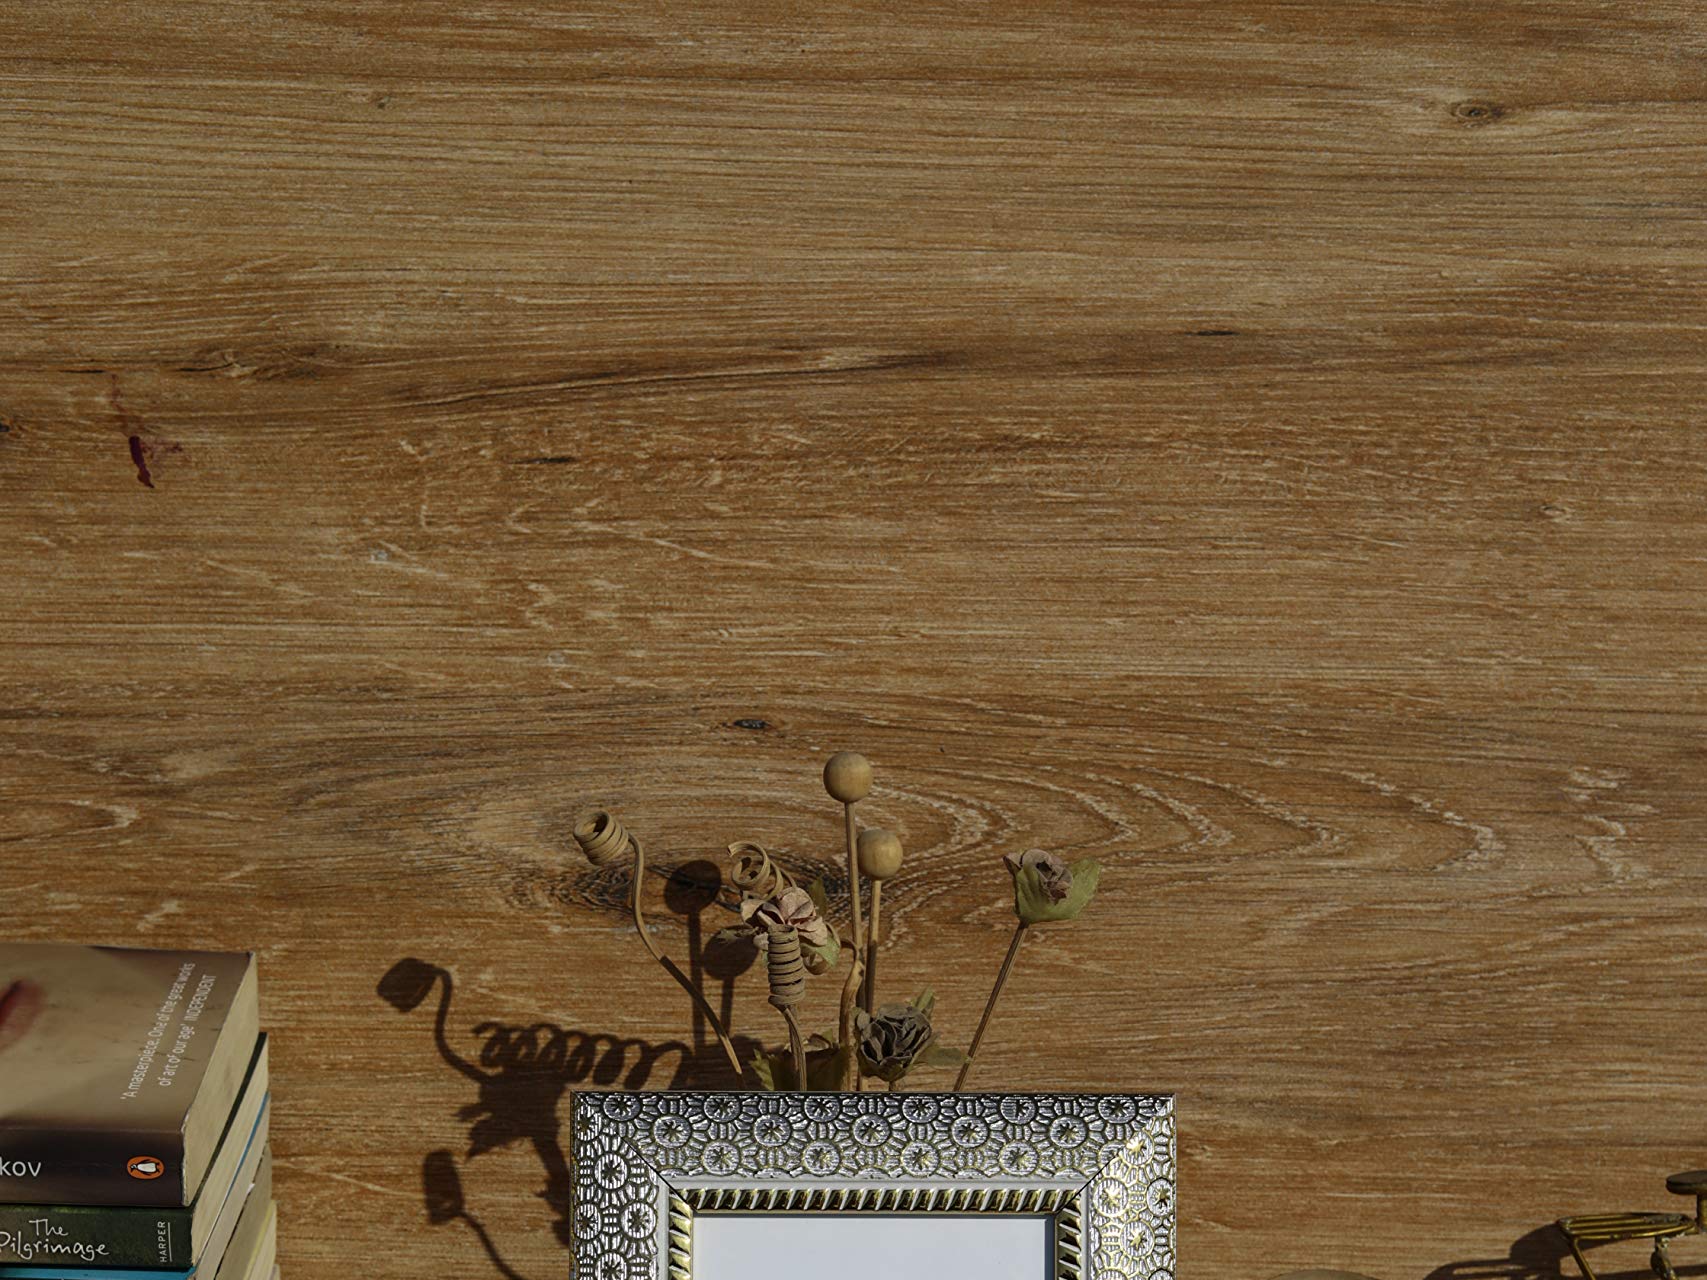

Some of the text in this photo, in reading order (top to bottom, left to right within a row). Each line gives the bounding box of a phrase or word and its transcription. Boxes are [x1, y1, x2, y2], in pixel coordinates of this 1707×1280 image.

[177, 962, 196, 982] works
[168, 982, 186, 1001] great
[184, 974, 217, 1021] INDEPENDENT
[161, 1001, 177, 1013] the
[156, 1012, 170, 1022] of
[148, 1022, 167, 1037] One
[172, 1040, 187, 1054] our
[167, 1053, 180, 1064] of
[163, 1064, 179, 1077] art
[158, 1076, 172, 1087] of
[0, 1156, 42, 1176] kov
[29, 1218, 69, 1236] The
[157, 1221, 168, 1263] HARPER
